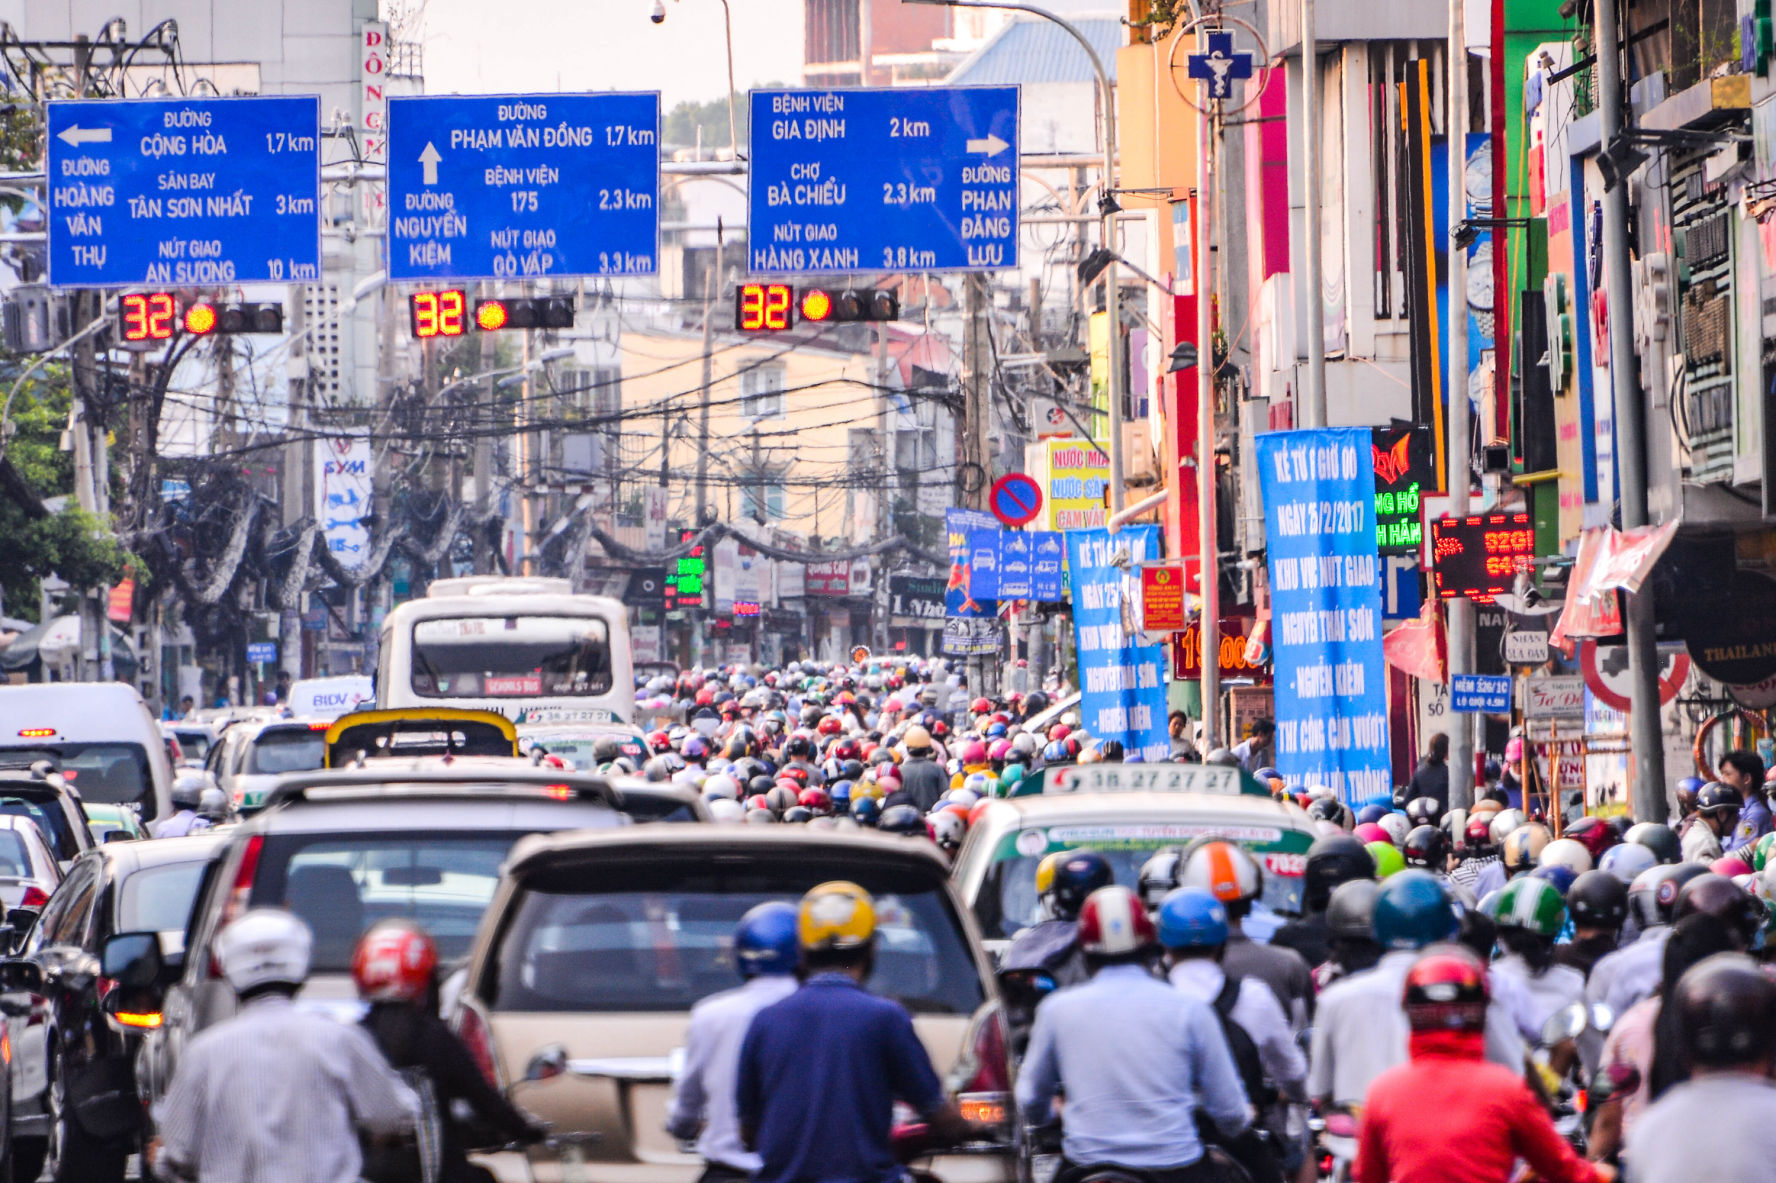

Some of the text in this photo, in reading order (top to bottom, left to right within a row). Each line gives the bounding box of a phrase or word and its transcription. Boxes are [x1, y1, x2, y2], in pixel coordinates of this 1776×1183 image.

[498, 101, 547, 121] ĐƯỜNG
[773, 93, 844, 116] BỆNH VIỆN
[164, 107, 212, 128] ĐƯỜNG
[451, 129, 502, 152] PHẠM
[506, 124, 540, 148] VĂN
[543, 121, 593, 147] ĐỒNG
[627, 126, 655, 146] km
[772, 118, 930, 142] GIA ĐỊNH 2 km
[141, 133, 186, 160] CỘNG
[192, 130, 227, 154] HÒA
[288, 133, 314, 152] km
[62, 155, 109, 176] ĐƯỜNG
[485, 164, 559, 188] BỆNH VIỆN
[791, 161, 820, 182] CHỢ
[962, 162, 1011, 184] ĐƯỜNG
[158, 170, 216, 190] SÂN BAY
[767, 181, 791, 207] BÀ
[795, 176, 846, 205] CHIỂU
[910, 183, 936, 204] km
[54, 182, 115, 208] HOÀNG
[128, 189, 314, 219] TÂN SƠN NHẤT 3 km
[405, 190, 454, 210] ĐƯỜNG
[511, 191, 538, 212] 175
[626, 188, 652, 209] km
[961, 190, 1012, 211] PHAN
[66, 212, 102, 236] VĂN
[395, 206, 467, 238] NGUYỄN
[774, 220, 838, 242] NÚT GIAO
[961, 214, 1011, 239] ĐĂNG
[159, 236, 222, 258] NÚT GIAO
[491, 226, 556, 249] NÚT GIAO
[71, 245, 107, 270] THỤ
[409, 241, 451, 271] KIỆM
[493, 250, 517, 275] GÒ
[521, 244, 554, 275] VẤP
[626, 251, 652, 272] km
[754, 245, 805, 270] HÀNG
[808, 247, 859, 269] XANH
[910, 247, 936, 268] km
[968, 244, 1004, 266] LƯU
[145, 258, 316, 284] AN SƯƠNG 10 km
[123, 292, 175, 340] 32
[413, 290, 466, 338] 32
[742, 284, 789, 330] 32
[325, 461, 365, 473] SYM
[1053, 446, 1084, 469] NƯỚC
[1274, 439, 1292, 483] KỂ
[1051, 476, 1082, 499] NƯỚC
[1057, 510, 1083, 529] CAM
[1277, 499, 1306, 537] NGÀY
[1319, 551, 1343, 587] NÚT
[1345, 553, 1375, 587] GIAO
[1348, 604, 1374, 643] SƠN
[313, 693, 348, 706] BIDV
